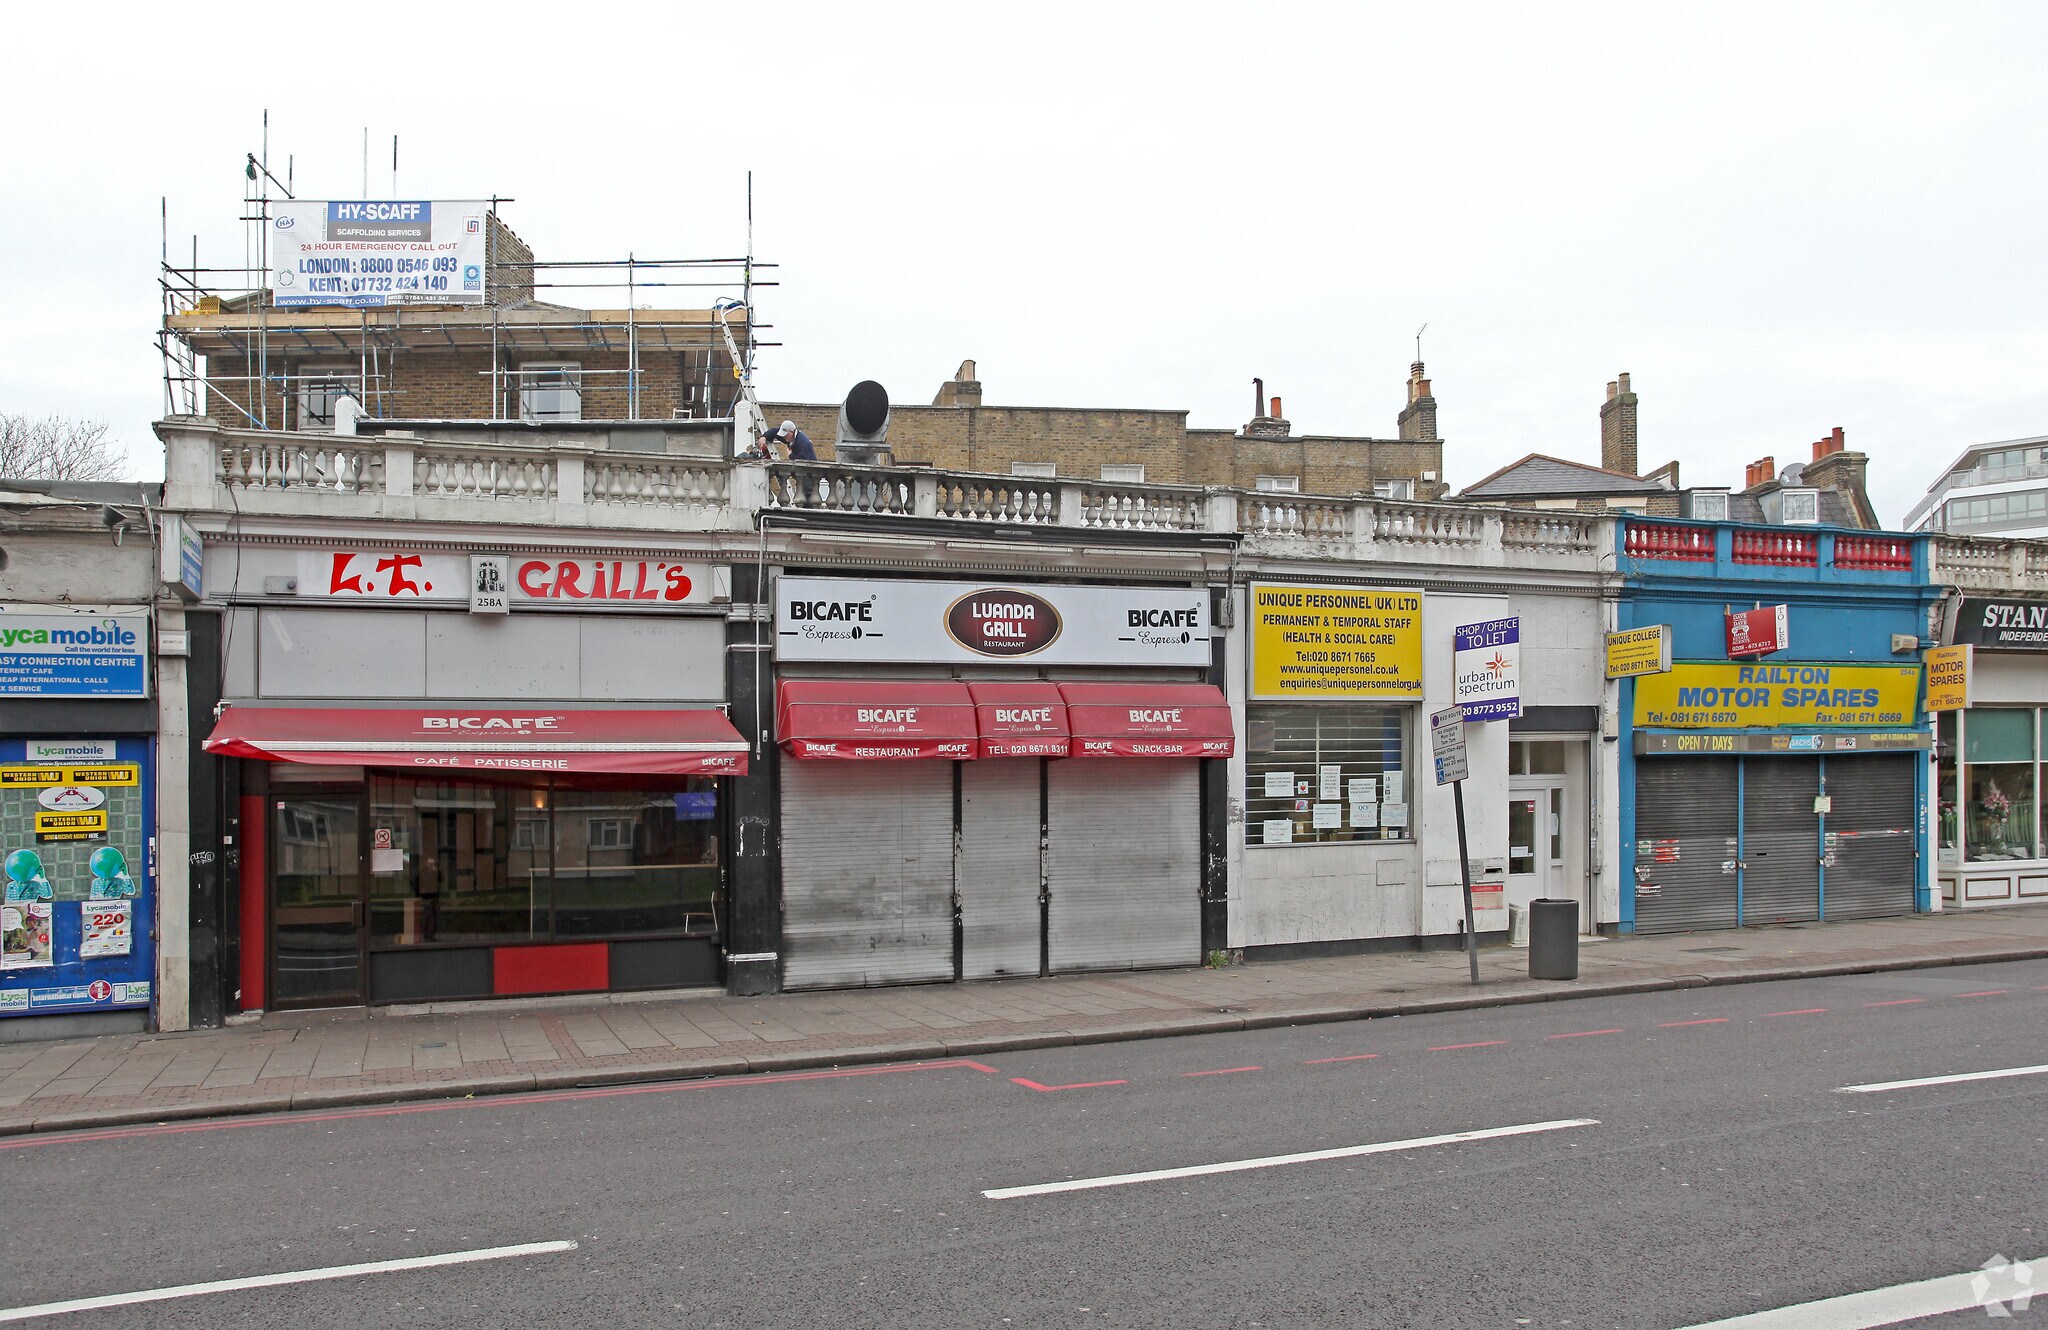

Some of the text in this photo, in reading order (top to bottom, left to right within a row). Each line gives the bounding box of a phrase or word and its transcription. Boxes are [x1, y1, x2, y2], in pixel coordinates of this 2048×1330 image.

[338, 203, 420, 220] HY-SCAFF
[336, 228, 386, 236] SCAFFOLDING
[300, 243, 312, 252] 24
[346, 243, 408, 251] EMERGENCY
[438, 242, 458, 250] OUT
[360, 258, 394, 273] 0800
[397, 258, 429, 273] 0546
[432, 257, 458, 272] 093
[352, 277, 392, 292] 01732
[396, 276, 419, 290] 424
[424, 274, 448, 290] 140
[478, 598, 502, 606] 258A
[1258, 592, 1418, 610] UNIQUE PERSONNEL (UK) LTD
[790, 600, 872, 622] BICAFÉ
[972, 602, 1034, 620] LUANDA
[1982, 604, 2048, 628] STAN
[1128, 608, 1198, 628] BICAFÉ
[1263, 614, 1411, 628] PERMANENT & TEMPORAL STAFF
[982, 622, 1026, 638] GRILL
[1457, 625, 1480, 636] SHOP
[1486, 618, 1518, 630] OFFICE
[1282, 632, 1396, 645] (HEALTH & SOCIAL CARE)
[1466, 631, 1507, 648] TO LET
[1608, 630, 1661, 646] UNIQUE COLLEGE
[20, 656, 136, 666] CONNECTION CENTRE
[1330, 652, 1352, 662] 8671
[1354, 652, 1376, 662] 7665
[1610, 664, 1620, 673] Tel:
[1620, 662, 1630, 672] 020
[1631, 660, 1644, 670] 8671
[1930, 660, 1964, 674] MOTOR
[1460, 671, 1494, 684] urban
[1738, 666, 1830, 684] RAILTON
[1930, 674, 1964, 687] SPARES
[1458, 679, 1514, 696] spectrum
[1678, 687, 1879, 708] MOTOR SPARES
[1930, 696, 1963, 706] 671 6670
[857, 707, 917, 723] BICAFÉ
[995, 707, 1052, 722] BICAFÉ
[1128, 708, 1182, 722] BICAFÉ
[1473, 704, 1494, 715] 8772
[1496, 702, 1517, 713] 9552
[422, 716, 558, 729] BICAFÉ
[1670, 712, 1690, 722] 081
[1692, 712, 1710, 722] 671
[1711, 712, 1737, 722] 6670
[1839, 712, 1856, 722] 081
[1858, 712, 1876, 722] 671
[1878, 712, 1902, 722] 6669
[1132, 744, 1183, 753] SNACK-BAR
[1677, 736, 1733, 750] OPEN 7 DAYS
[1790, 738, 1812, 746] SACHS
[37, 745, 104, 756] Lycamobile
[855, 747, 920, 758] RESTAURANT
[988, 744, 1068, 754] TEL: 020 8671 8311
[414, 756, 568, 769] CAFÉ PATISSERIE
[93, 914, 124, 926] 220
